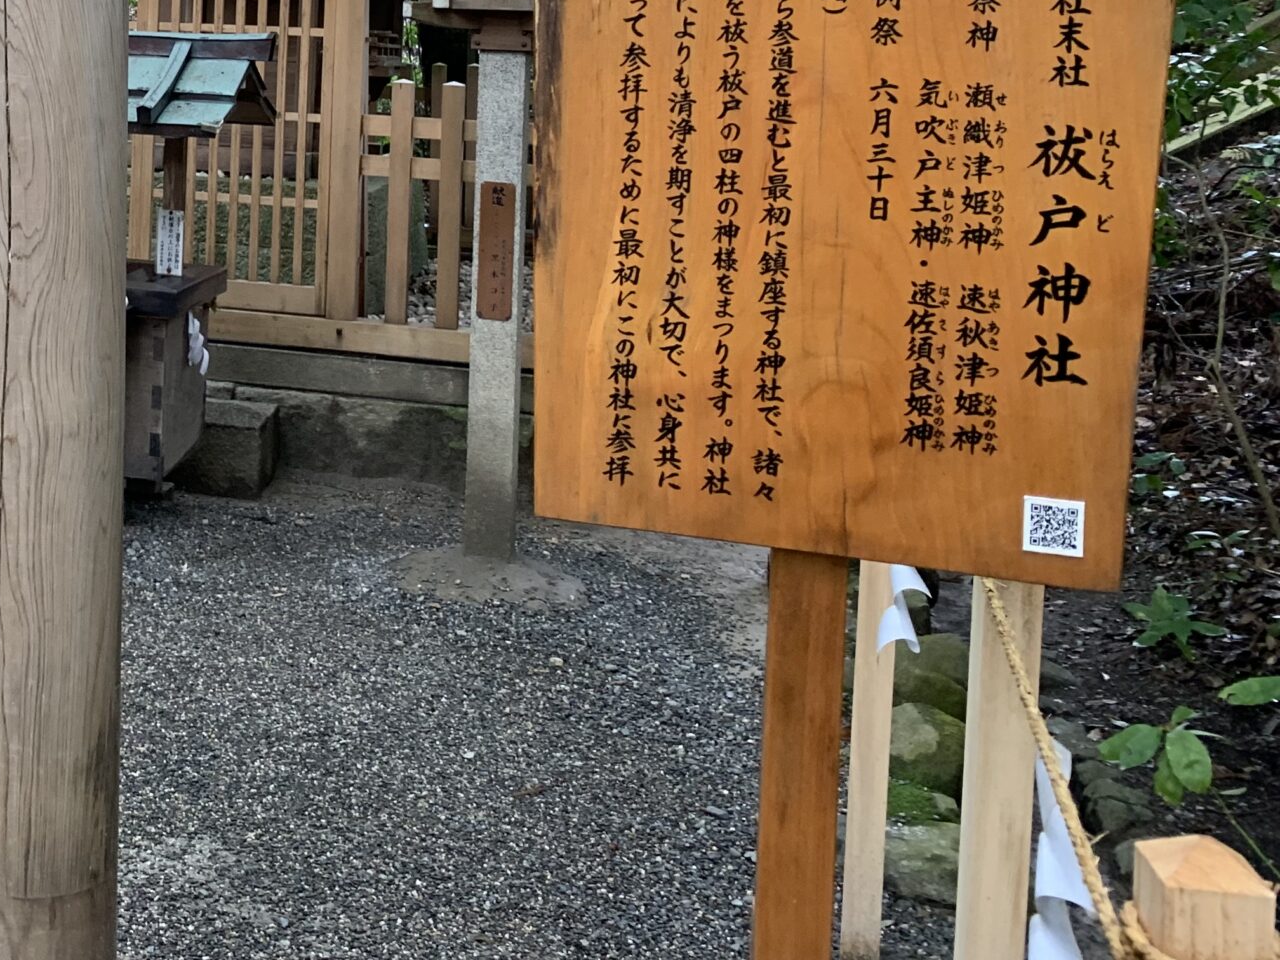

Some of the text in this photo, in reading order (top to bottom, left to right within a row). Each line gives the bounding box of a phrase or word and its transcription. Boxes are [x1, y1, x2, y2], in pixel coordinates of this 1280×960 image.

[867, 77, 899, 222] 六月三十日
[1021, 124, 1097, 387] 祓戸神社
[950, 284, 991, 455] 速秋津姫神
